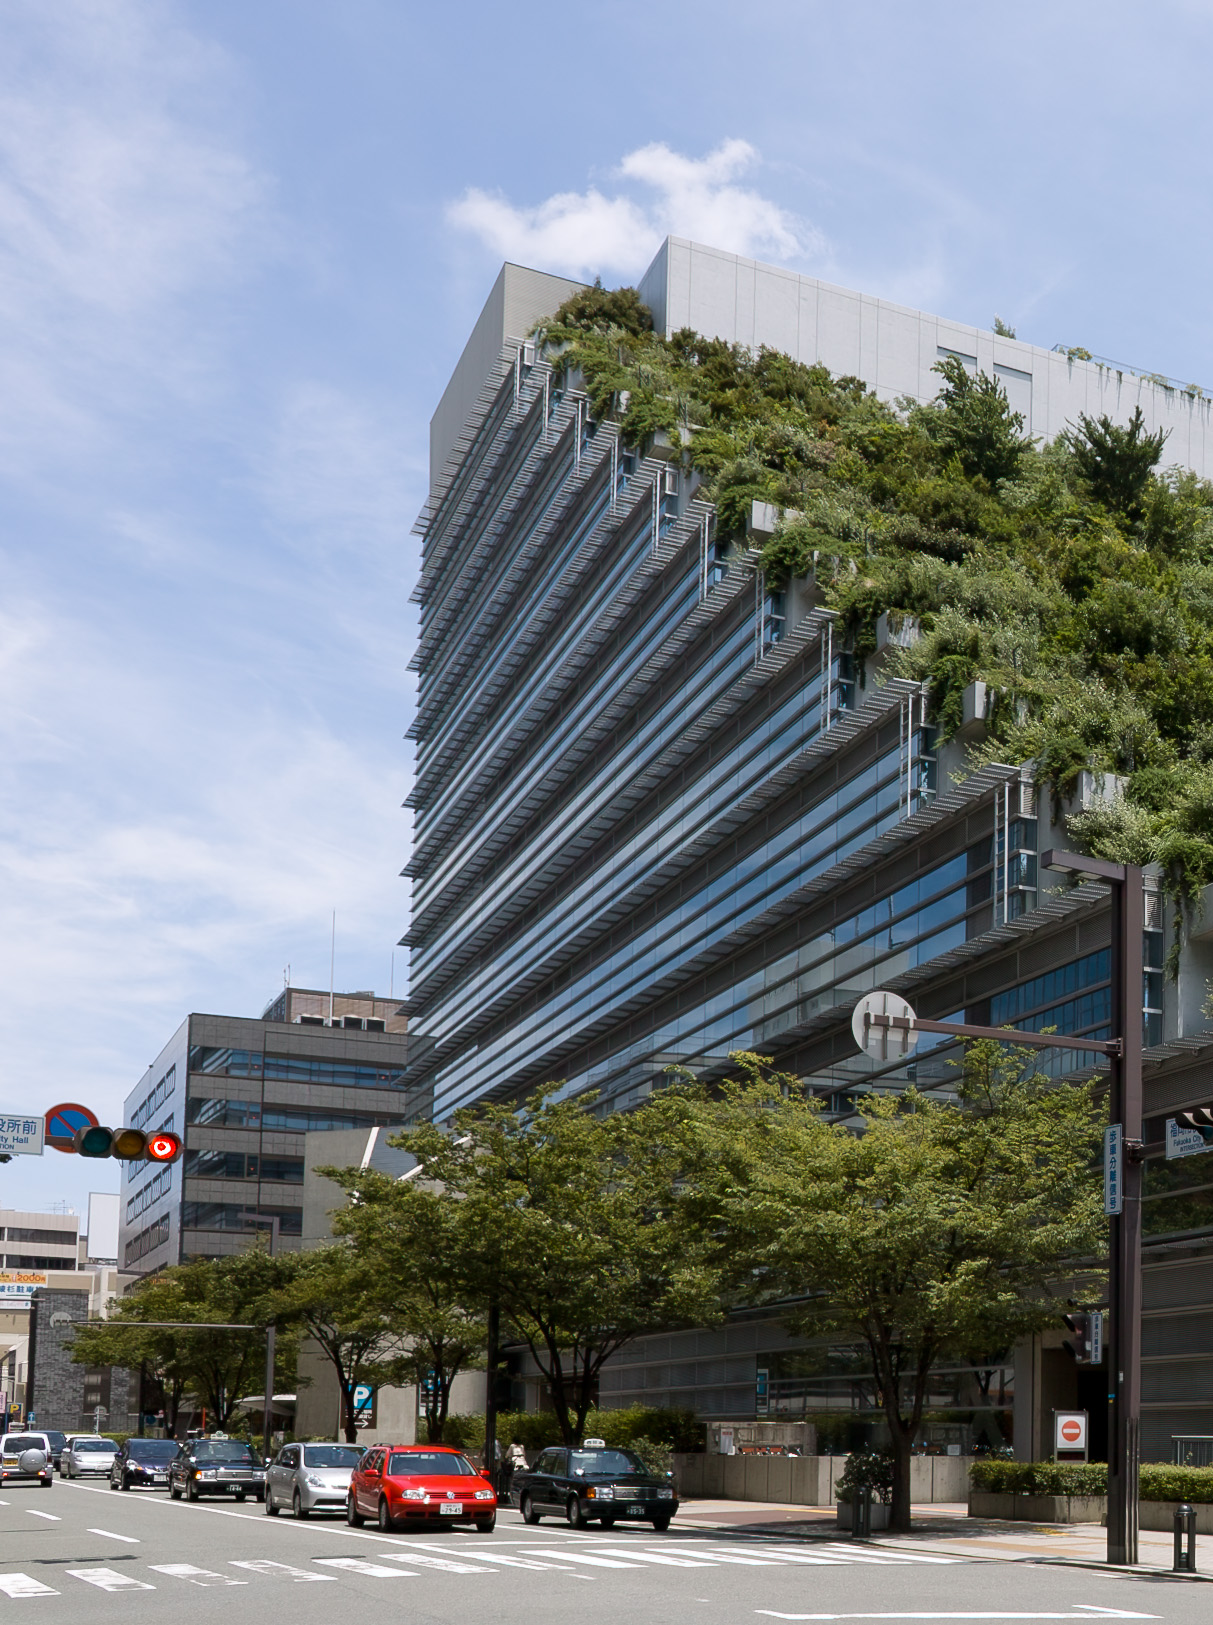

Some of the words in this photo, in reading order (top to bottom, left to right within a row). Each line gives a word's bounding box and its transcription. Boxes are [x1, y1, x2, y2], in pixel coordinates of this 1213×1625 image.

[12, 1136, 29, 1144] Hall
[1173, 1137, 1192, 1147] Fukuoka
[1109, 1130, 1117, 1209] 歩車分離信号
[353, 1386, 370, 1407] P
[10, 1404, 20, 1414] P
